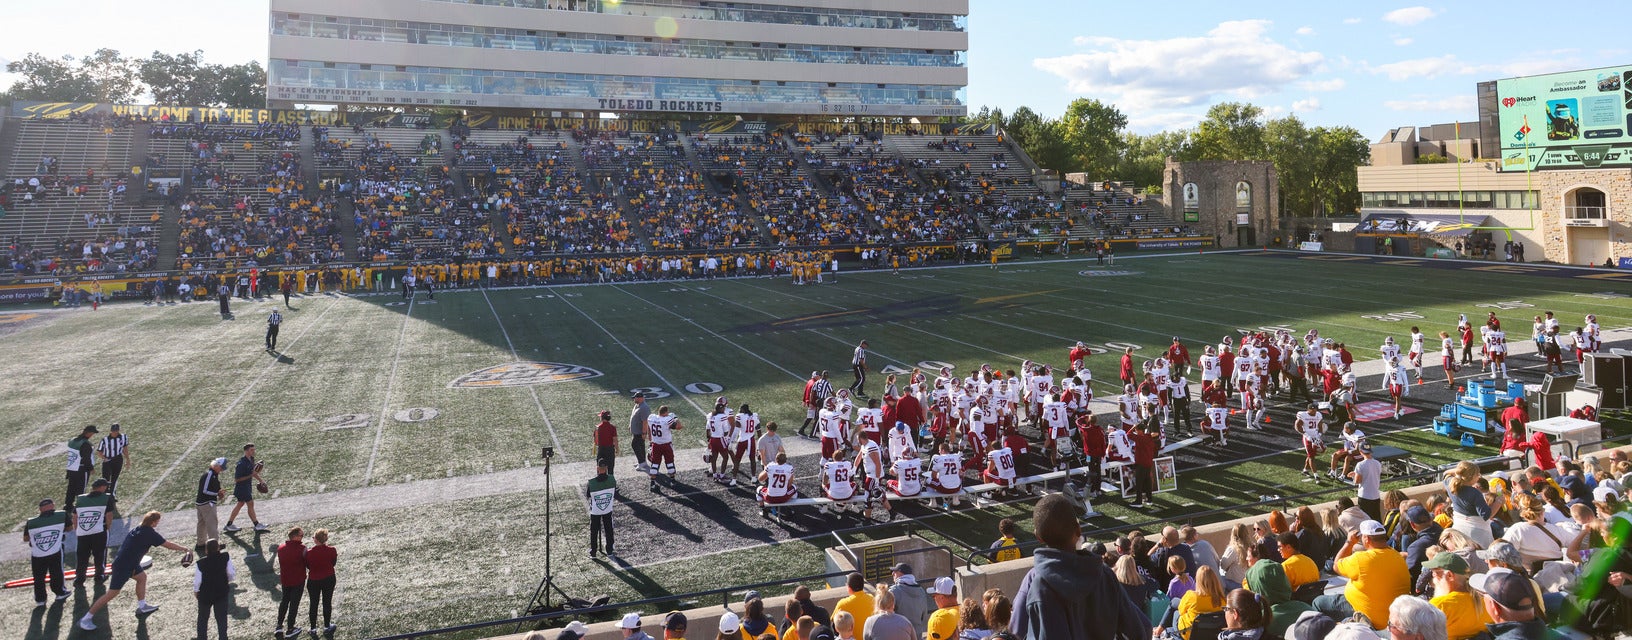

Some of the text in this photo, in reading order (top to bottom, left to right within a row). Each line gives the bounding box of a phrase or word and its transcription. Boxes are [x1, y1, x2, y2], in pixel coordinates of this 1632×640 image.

[301, 88, 372, 96] CHAMPIONSHIPS
[598, 98, 722, 112] TOLEDO ROCKETS
[224, 108, 253, 124] THE
[258, 110, 307, 124] GLASS
[498, 117, 530, 130] HOME
[798, 123, 844, 134] WELCOME
[884, 124, 914, 135] GLASS
[1491, 337, 1501, 345] 24
[1204, 361, 1212, 370] 19
[1240, 363, 1250, 371] 97
[1038, 382, 1048, 392] 94
[1177, 387, 1181, 395] 1
[1130, 402, 1137, 413] 10
[1051, 408, 1058, 421] 3
[1215, 413, 1221, 424] 2
[745, 420, 755, 433] 18
[821, 418, 828, 432] 57
[863, 415, 875, 428] 54
[651, 424, 662, 437] 66
[944, 462, 957, 475] 72
[1000, 454, 1013, 470] 80
[772, 474, 786, 488] 79
[835, 469, 848, 482] 63
[905, 468, 917, 481] 55
[79, 514, 100, 524] MAC
[35, 534, 59, 545] MAC
